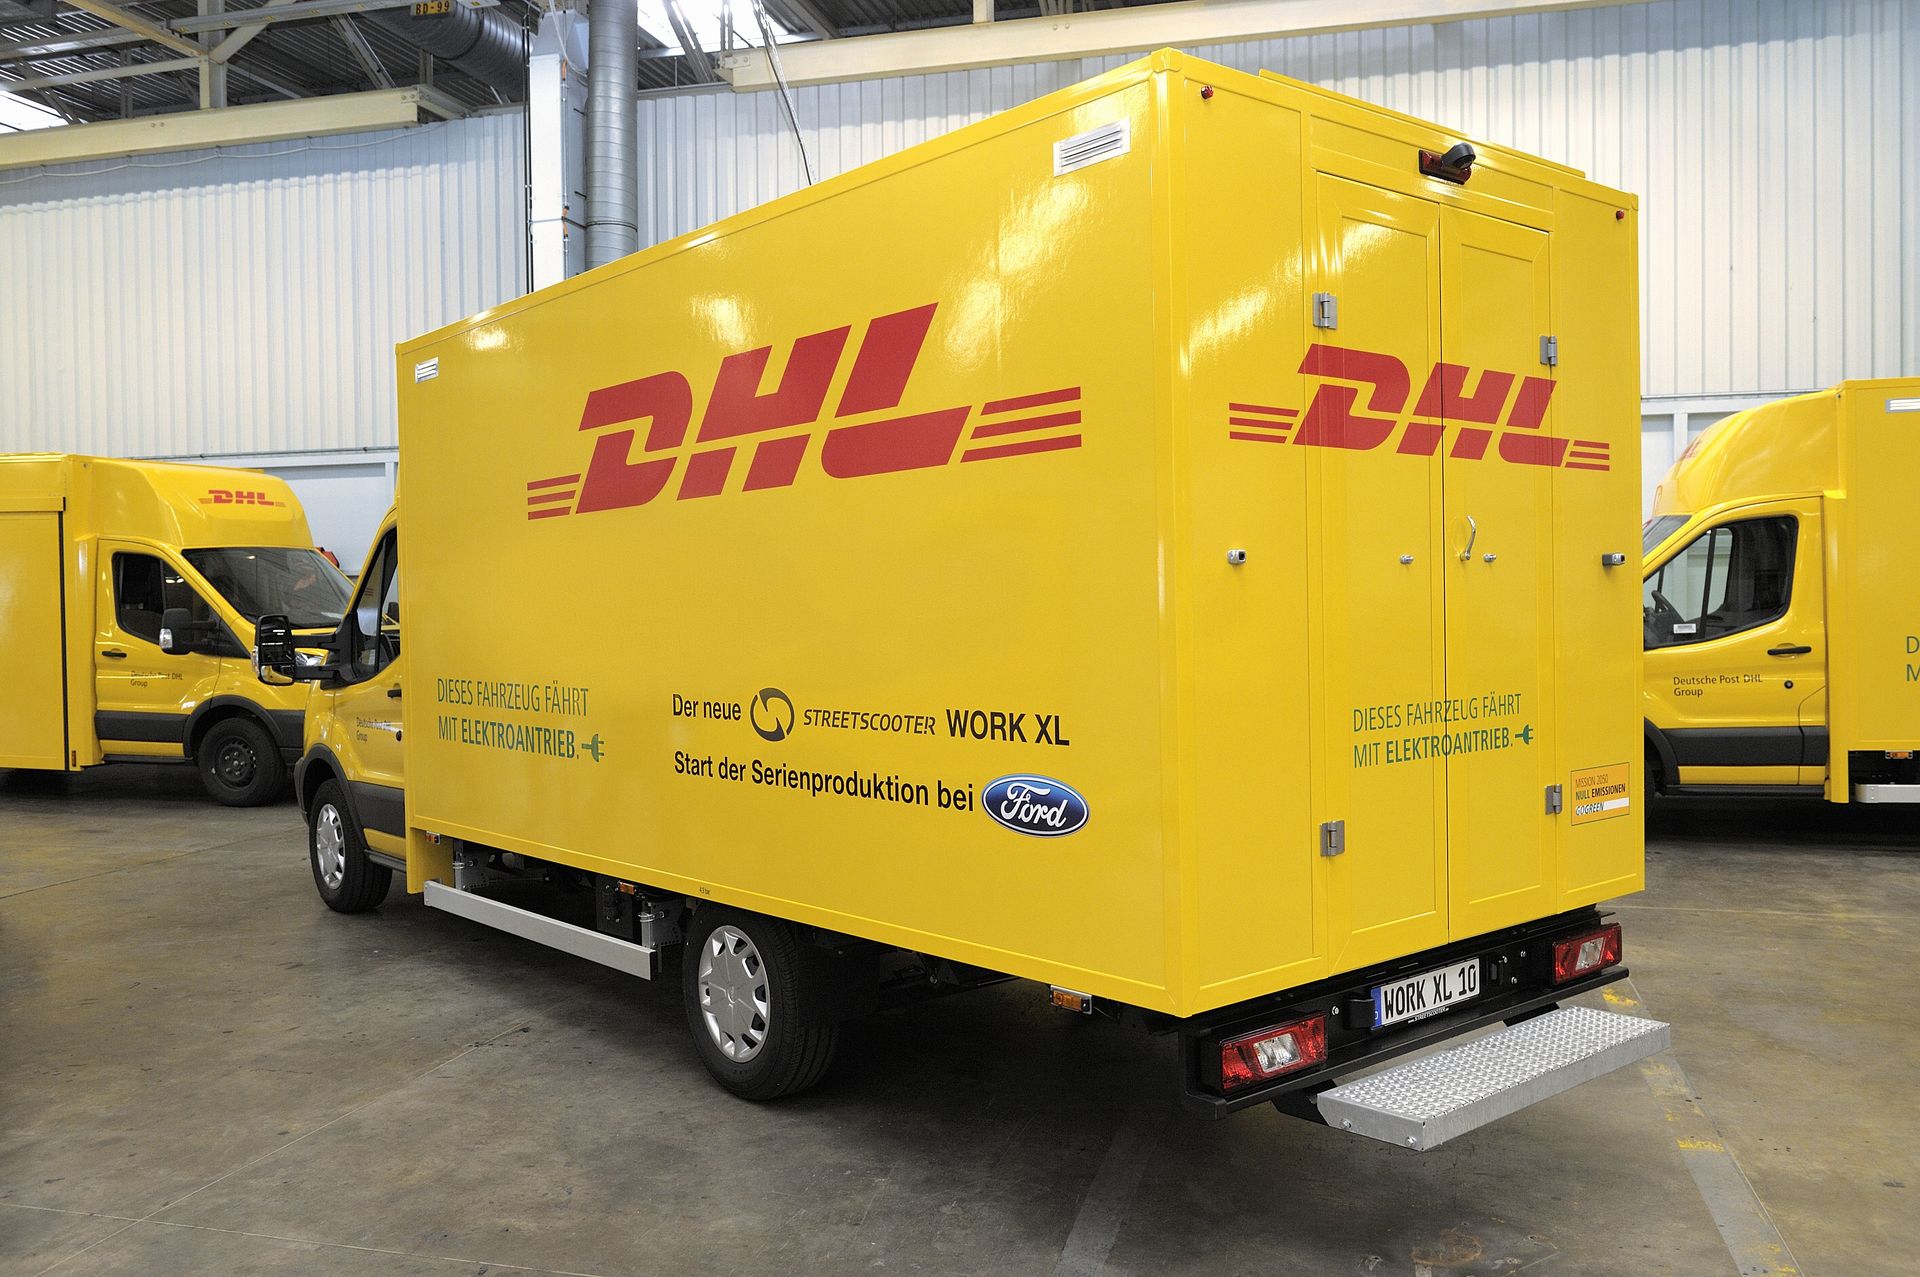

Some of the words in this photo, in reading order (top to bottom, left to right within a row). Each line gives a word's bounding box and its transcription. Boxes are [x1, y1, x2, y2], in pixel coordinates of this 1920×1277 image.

[575, 302, 972, 515] DHL
[1292, 343, 1571, 468] DHL
[208, 489, 275, 506] DHL
[437, 678, 473, 704] DIESES
[476, 680, 540, 712] FAHRZEUG
[545, 680, 589, 717] FÄHRT
[1673, 674, 1718, 686] Deutsche
[1719, 674, 1740, 684] Post
[1743, 673, 1764, 683] DHL
[1673, 687, 1704, 698] Group
[672, 693, 699, 718] Der
[703, 700, 742, 721] neue
[803, 709, 936, 736] STREETSCOOTER
[946, 708, 1028, 744] WORK
[1034, 714, 1070, 747] XL
[1353, 704, 1402, 733] DIESES
[1406, 696, 1478, 727] FAHRZEUG
[1482, 690, 1522, 718] FÄHRT
[438, 715, 458, 742] MIT
[460, 718, 580, 760] ELEKTROANTRIEB.
[1353, 742, 1381, 769] MIT
[1385, 726, 1514, 765] ELEKTROANTRIEB.
[674, 750, 714, 778] Start
[718, 757, 746, 782] der
[751, 759, 930, 807] Serienproduktion
[937, 780, 975, 812] bei
[999, 782, 1070, 829] Ford
[1575, 789, 1591, 801] NULL
[1591, 783, 1626, 797] EMISSIONEN
[1576, 776, 1596, 788] MISSION
[1575, 801, 1605, 816] GOGREEN
[1384, 979, 1426, 1019] WORK
[1433, 973, 1453, 1004] XL
[1458, 964, 1476, 996] 10
